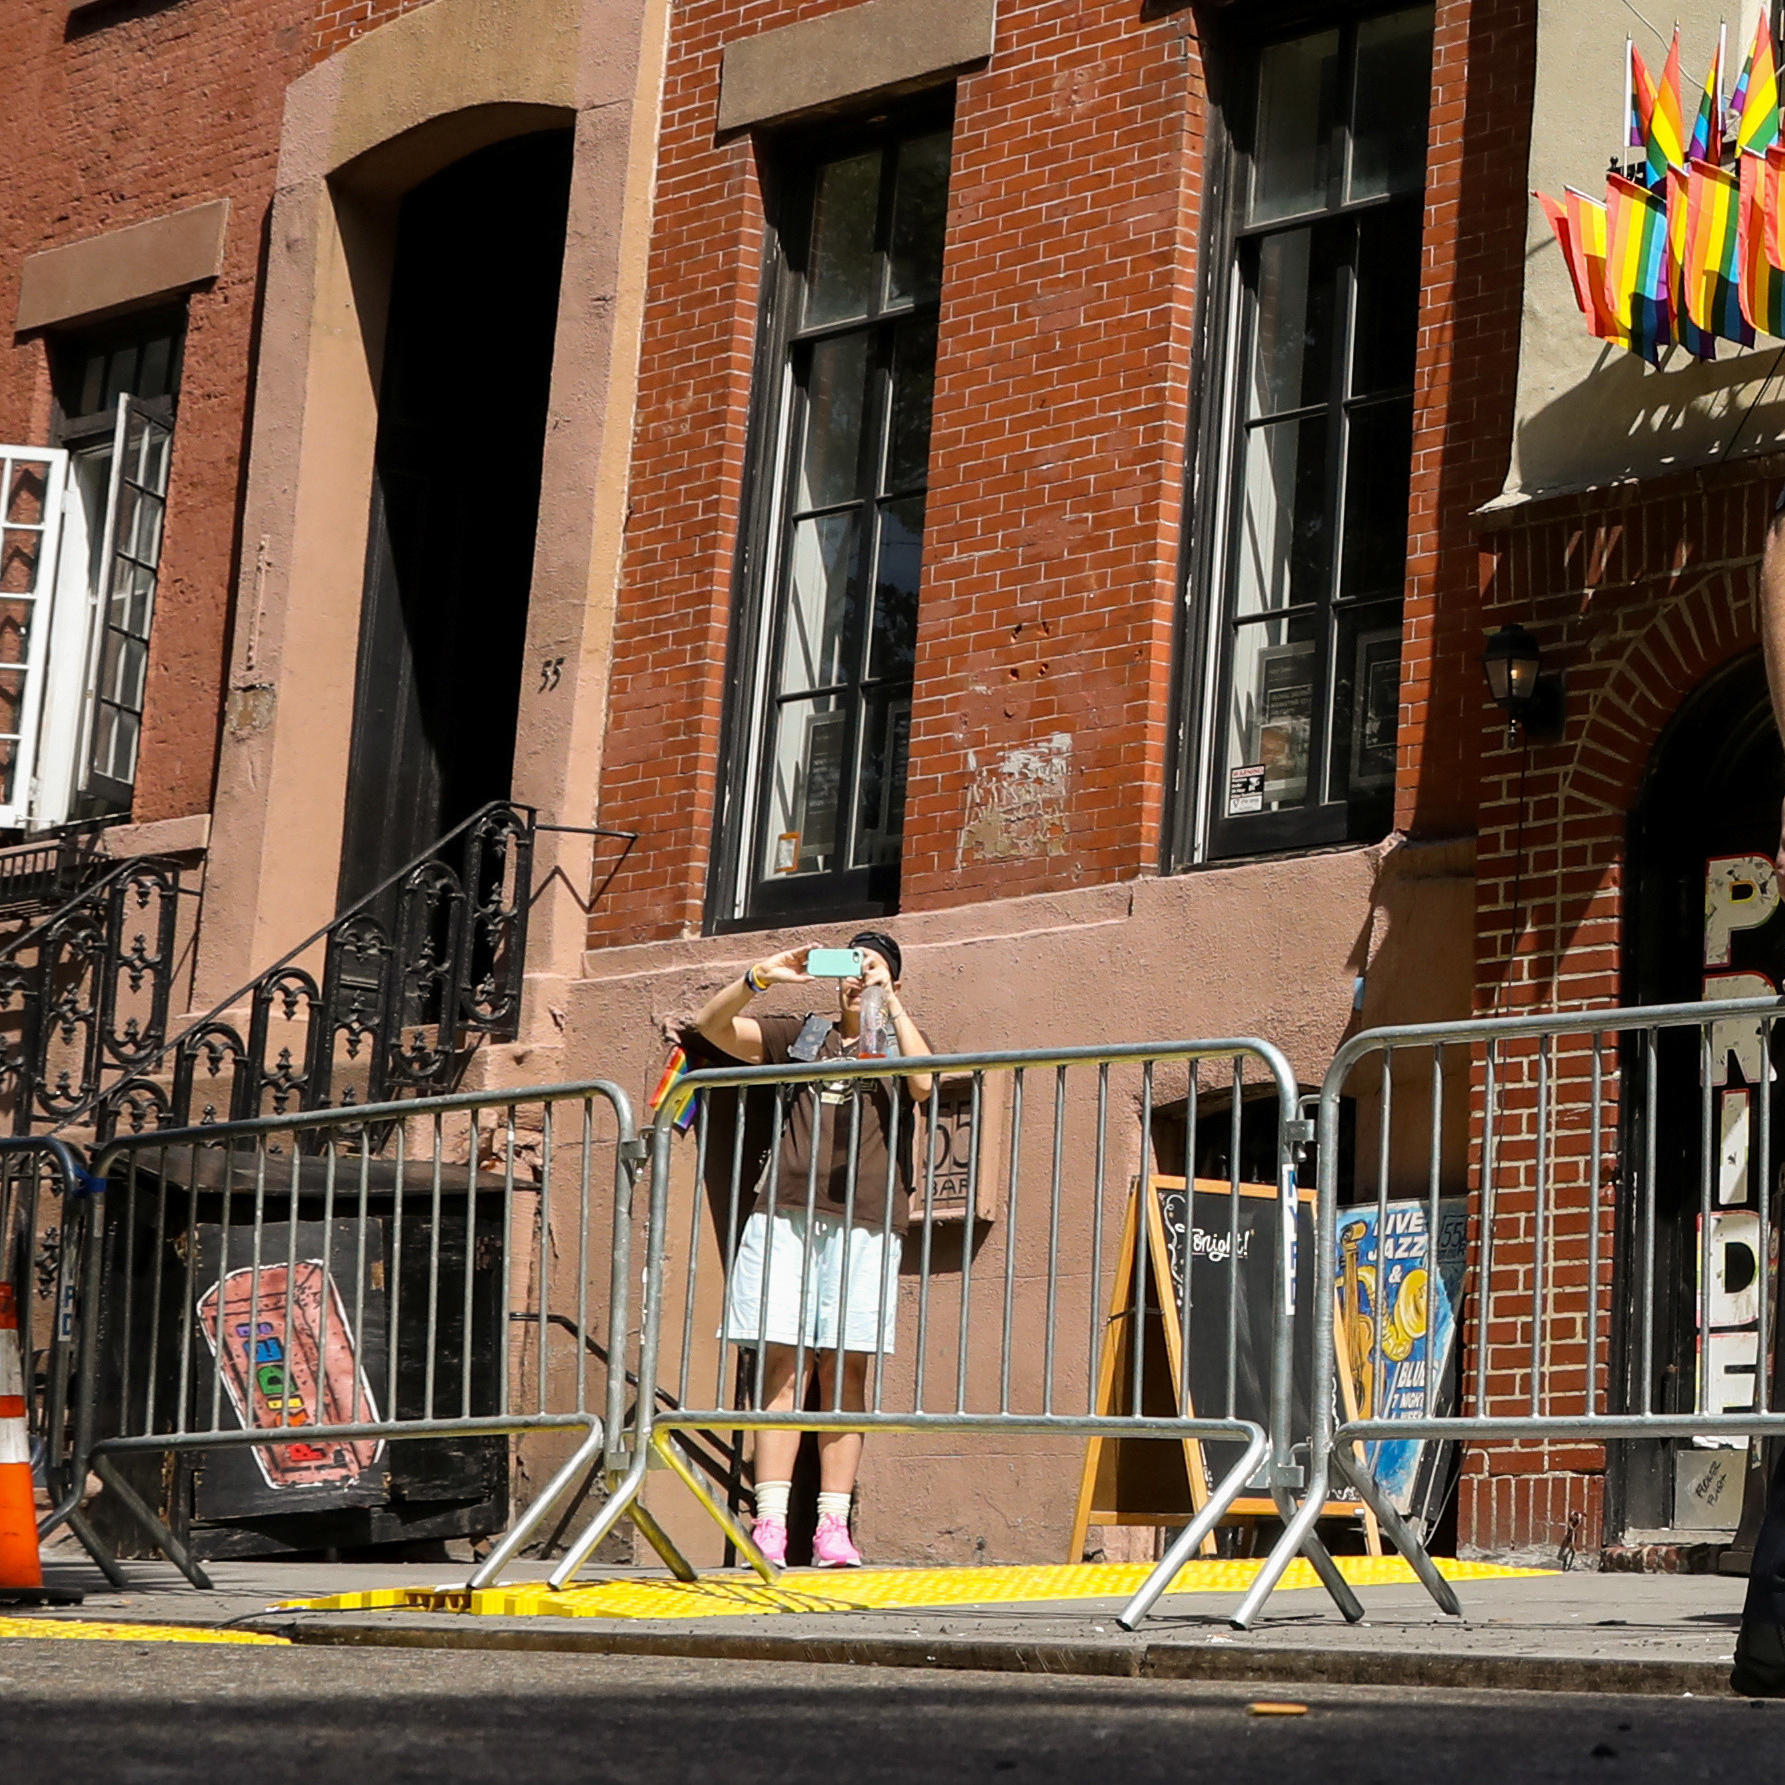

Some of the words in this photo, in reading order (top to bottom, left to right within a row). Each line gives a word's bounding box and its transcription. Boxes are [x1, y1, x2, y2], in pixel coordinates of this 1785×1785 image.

[537, 656, 565, 694] 55
[1368, 1234, 1429, 1261] JAZZ
[1388, 1264, 1403, 1283] &
